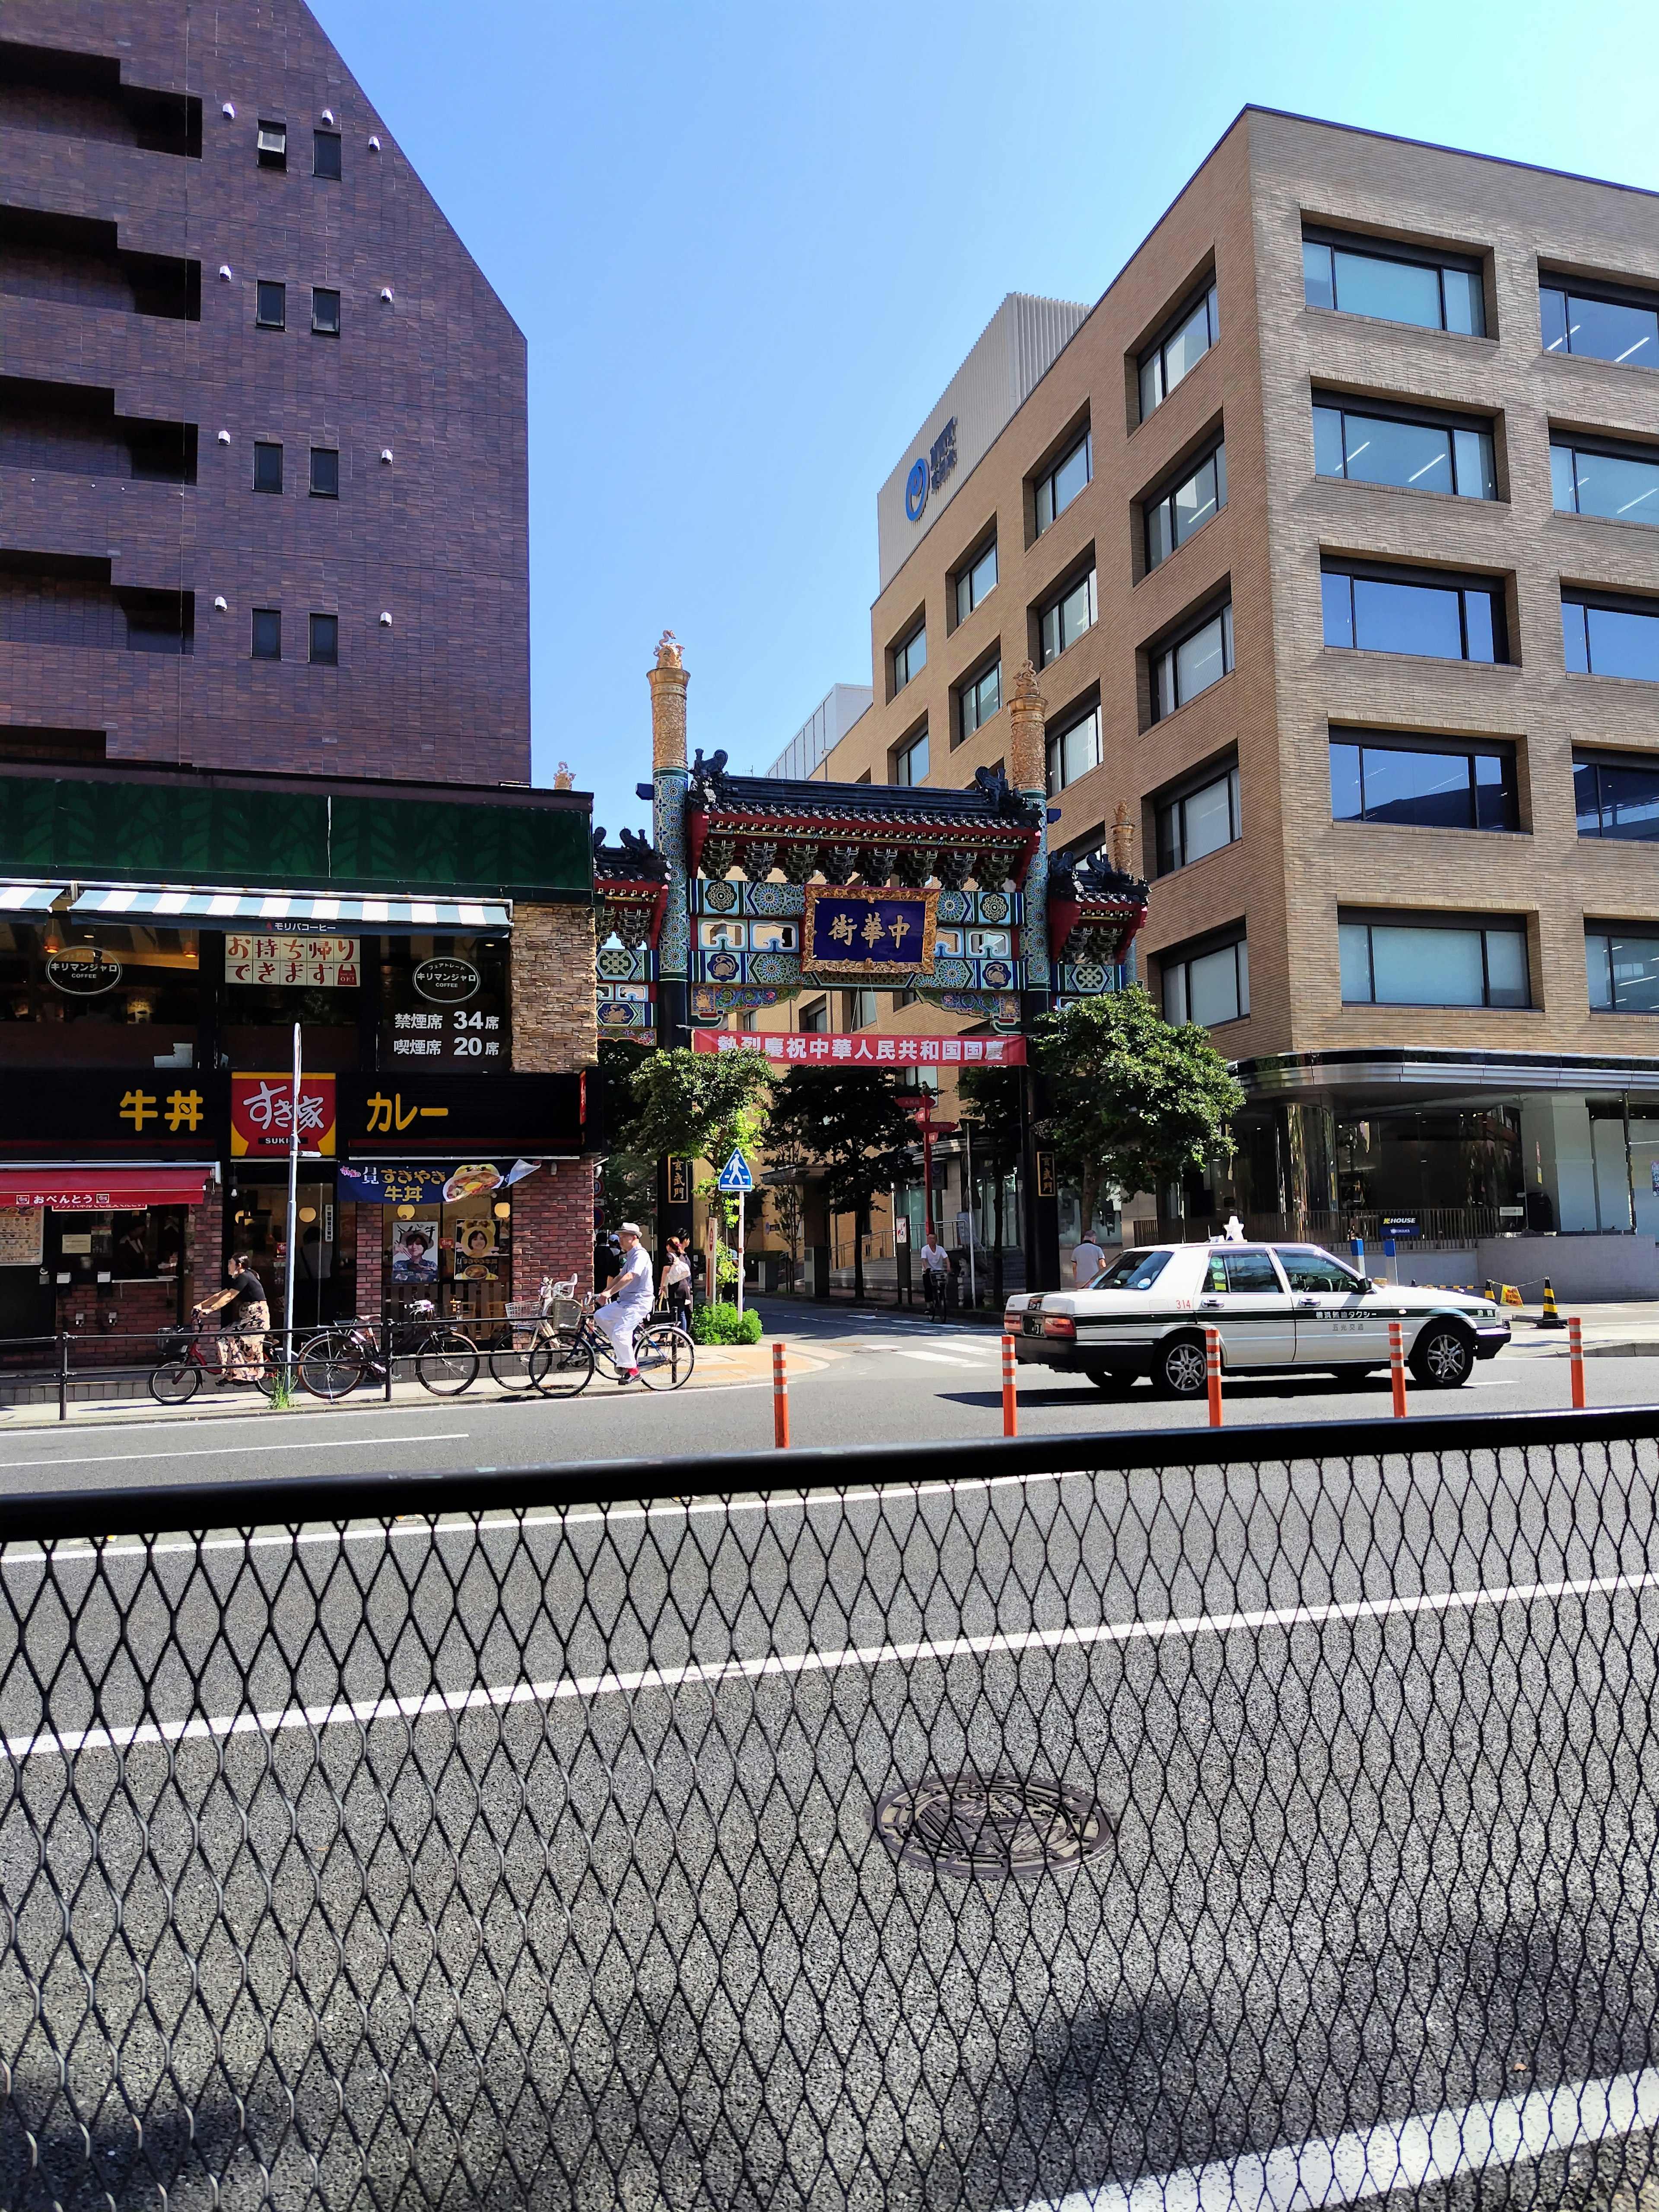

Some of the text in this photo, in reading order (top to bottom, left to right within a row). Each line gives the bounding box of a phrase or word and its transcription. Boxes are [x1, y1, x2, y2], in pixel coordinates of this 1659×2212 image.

[275, 922, 336, 931] モリバコーヒー
[228, 936, 354, 961] お持ち帰り
[51, 963, 118, 972] キリマンジャロ
[227, 962, 333, 985] できます
[428, 963, 466, 971] フェアトレード
[417, 972, 476, 982] キリマンジャロ
[394, 1013, 443, 1030] 禁煙席
[394, 1039, 442, 1055] 喫煙席
[119, 1089, 204, 1132] 牛丼
[242, 1081, 325, 1135] すき家
[366, 1091, 449, 1132] カレー
[362, 1166, 379, 1185] 月見
[381, 1168, 446, 1185] すきやき
[672, 1158, 685, 1200] 玄武門
[1041, 1155, 1053, 1193] 玄武門
[33, 1194, 93, 1204] おべんとう
[384, 1185, 423, 1202] 牛丼
[1176, 1300, 1191, 1309] 314
